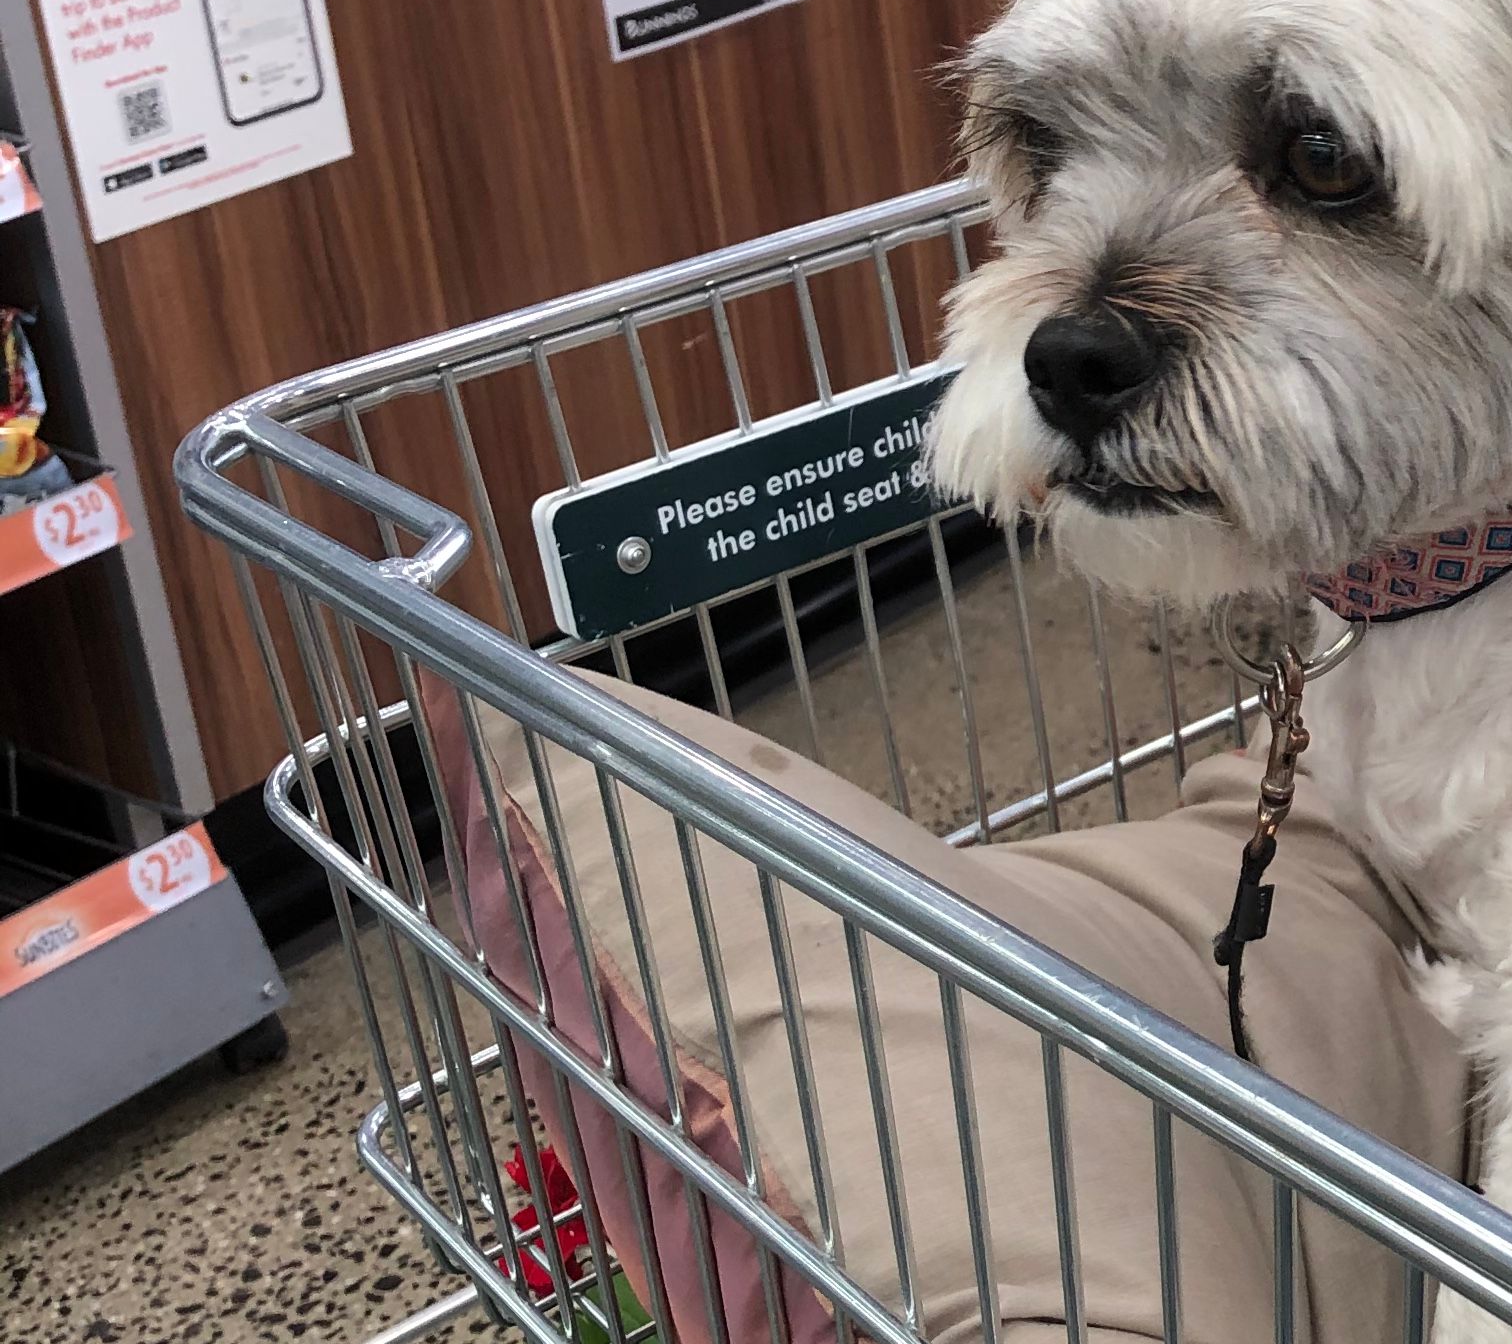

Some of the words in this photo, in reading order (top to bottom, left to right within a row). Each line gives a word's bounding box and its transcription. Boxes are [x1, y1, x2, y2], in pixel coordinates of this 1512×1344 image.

[656, 482, 757, 536] Please
[765, 442, 865, 498] ensure
[706, 520, 756, 563] the
[765, 491, 836, 542] child
[843, 470, 902, 515] seat
[910, 458, 933, 489] &
